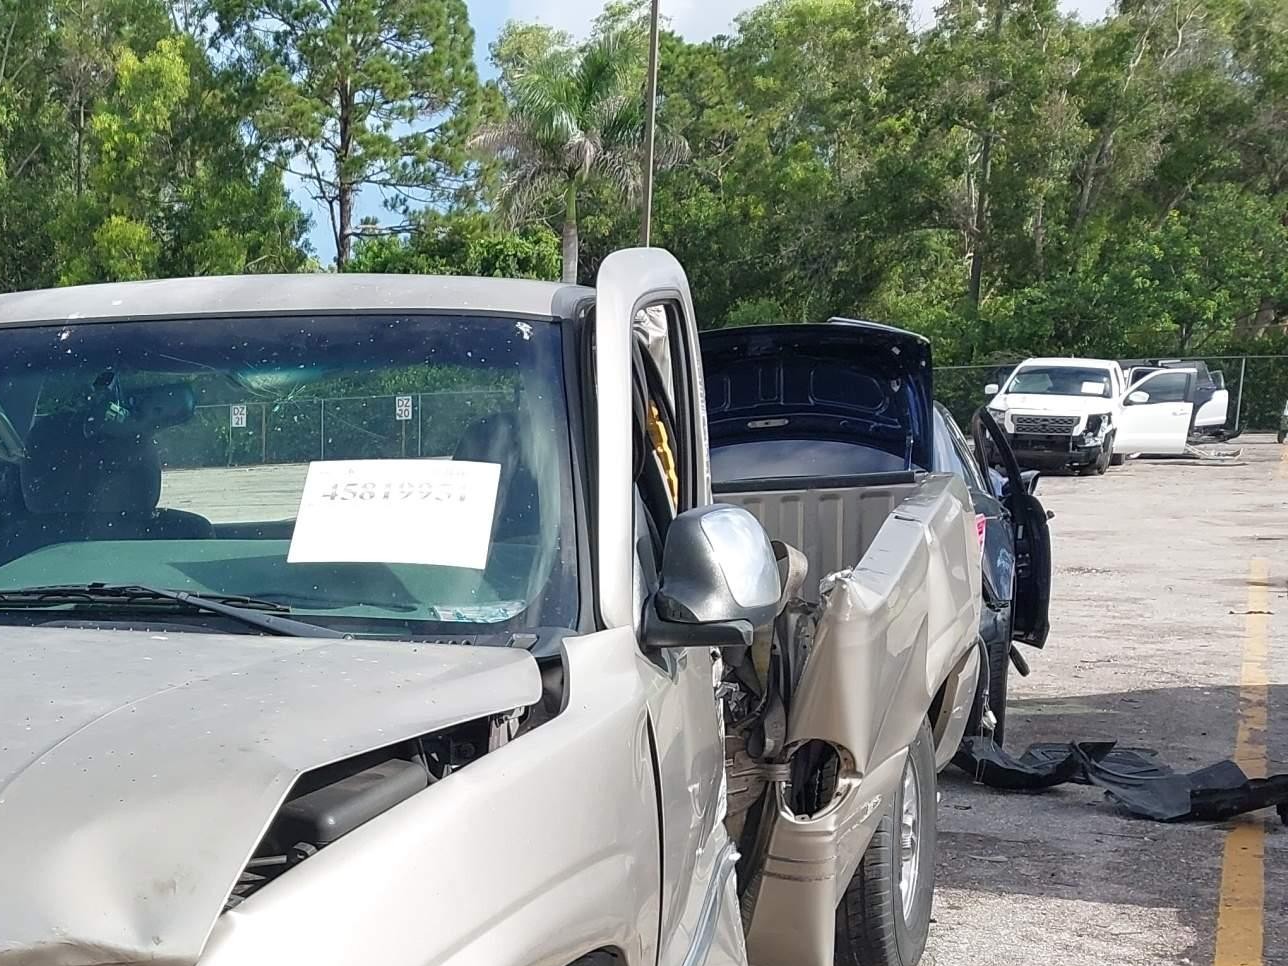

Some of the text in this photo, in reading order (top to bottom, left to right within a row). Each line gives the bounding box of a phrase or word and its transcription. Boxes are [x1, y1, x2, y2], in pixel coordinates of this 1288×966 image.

[397, 398, 410, 408] DZ
[233, 406, 245, 416] DZ
[397, 408, 409, 418] 20
[235, 416, 243, 425] 21
